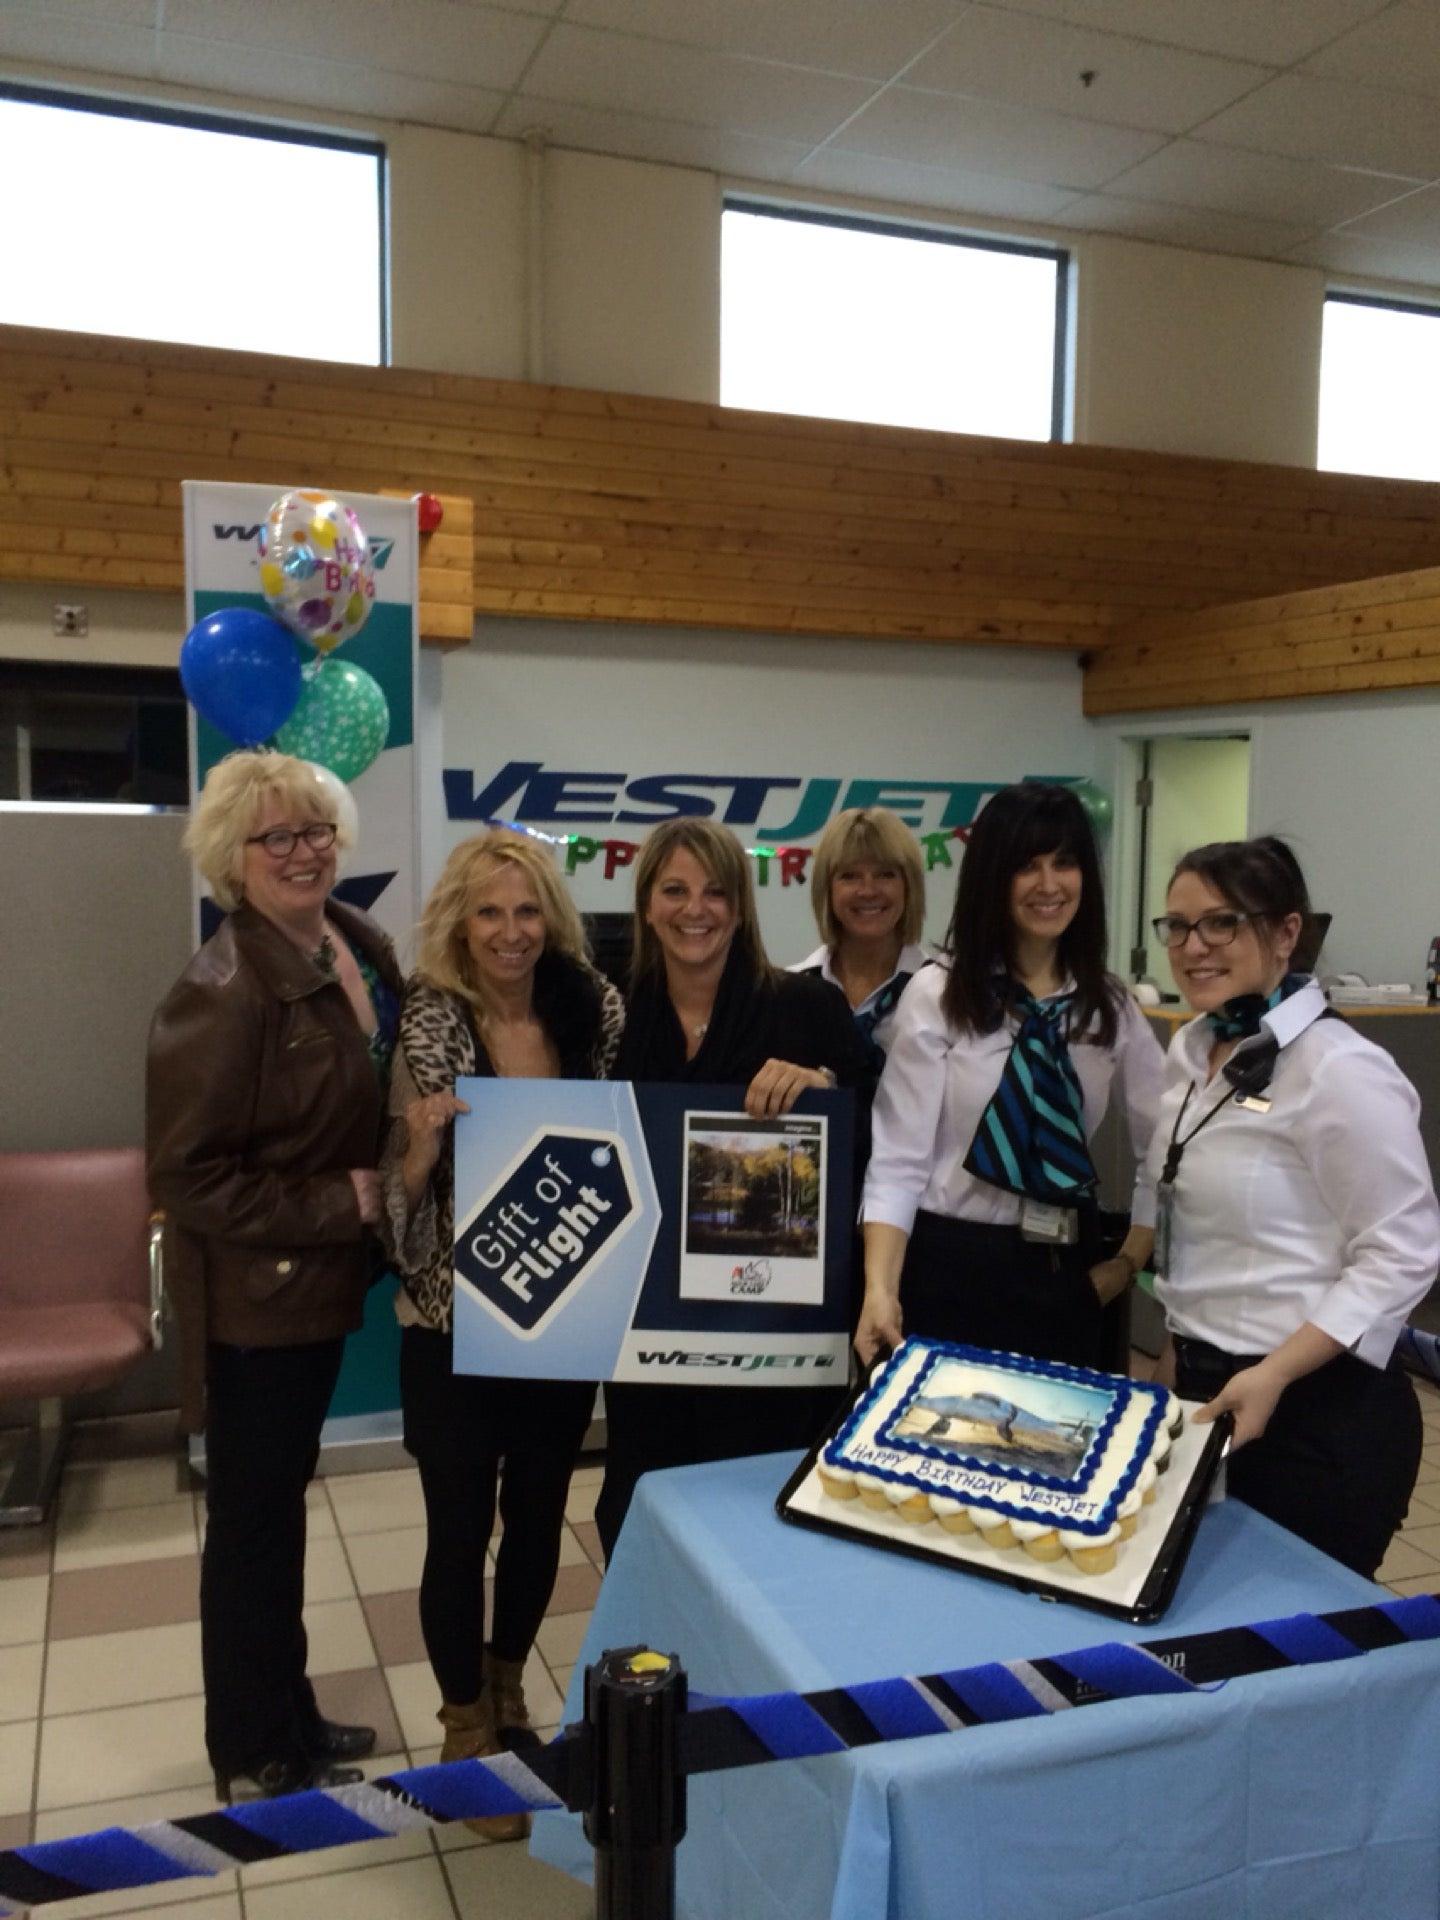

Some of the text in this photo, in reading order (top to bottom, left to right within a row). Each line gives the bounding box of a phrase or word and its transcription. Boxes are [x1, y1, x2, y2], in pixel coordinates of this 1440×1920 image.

[471, 1153, 573, 1270] Gift of
[500, 1185, 613, 1304] Flight
[637, 1350, 817, 1371] WESTJET
[849, 1443, 908, 1467] HAPPY
[915, 1459, 1008, 1495] BIRTHDAY
